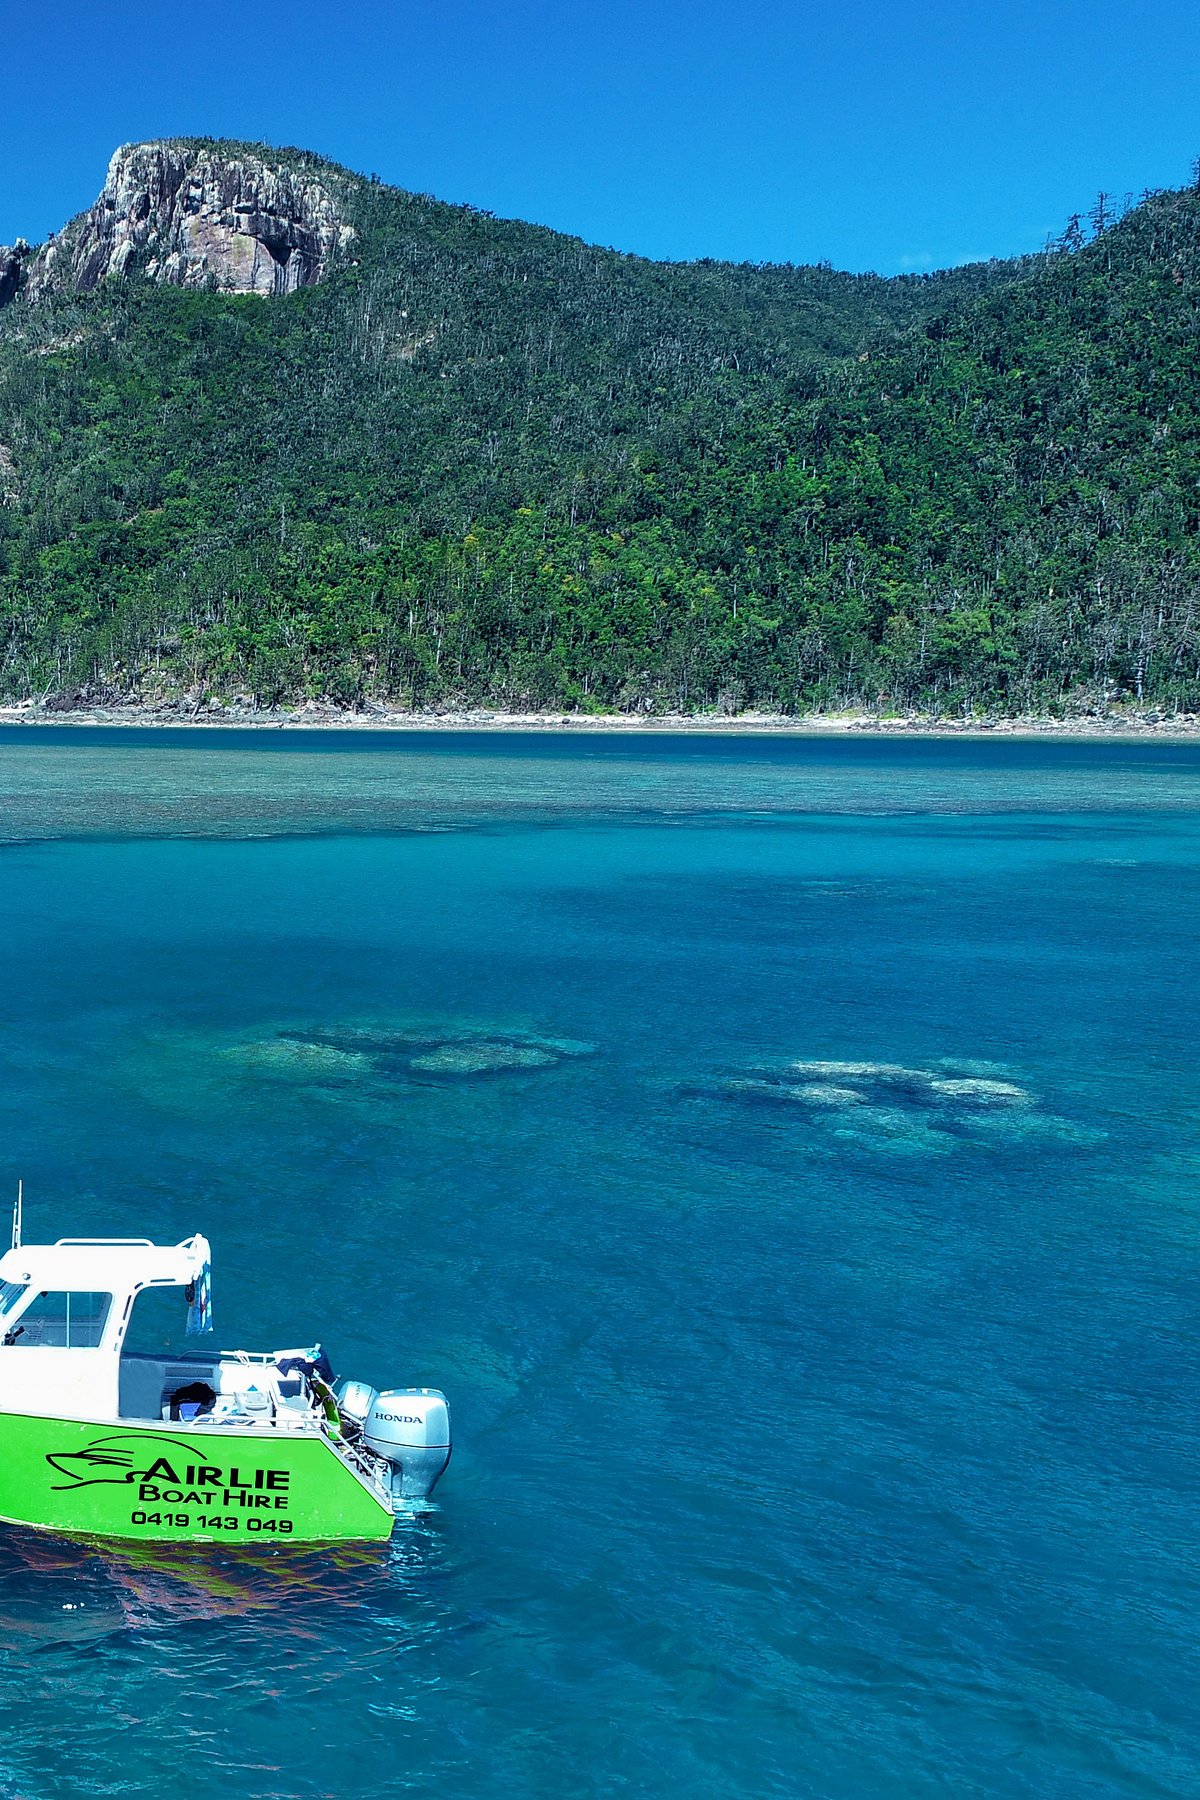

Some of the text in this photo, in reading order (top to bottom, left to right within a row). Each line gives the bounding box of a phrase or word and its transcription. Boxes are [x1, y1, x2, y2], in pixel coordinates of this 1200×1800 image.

[375, 1412, 423, 1424] HONDA
[140, 1457, 290, 1491] AIRLIE
[138, 1484, 289, 1510] BOAT HIRE
[131, 1511, 293, 1534] 0419 143 049
